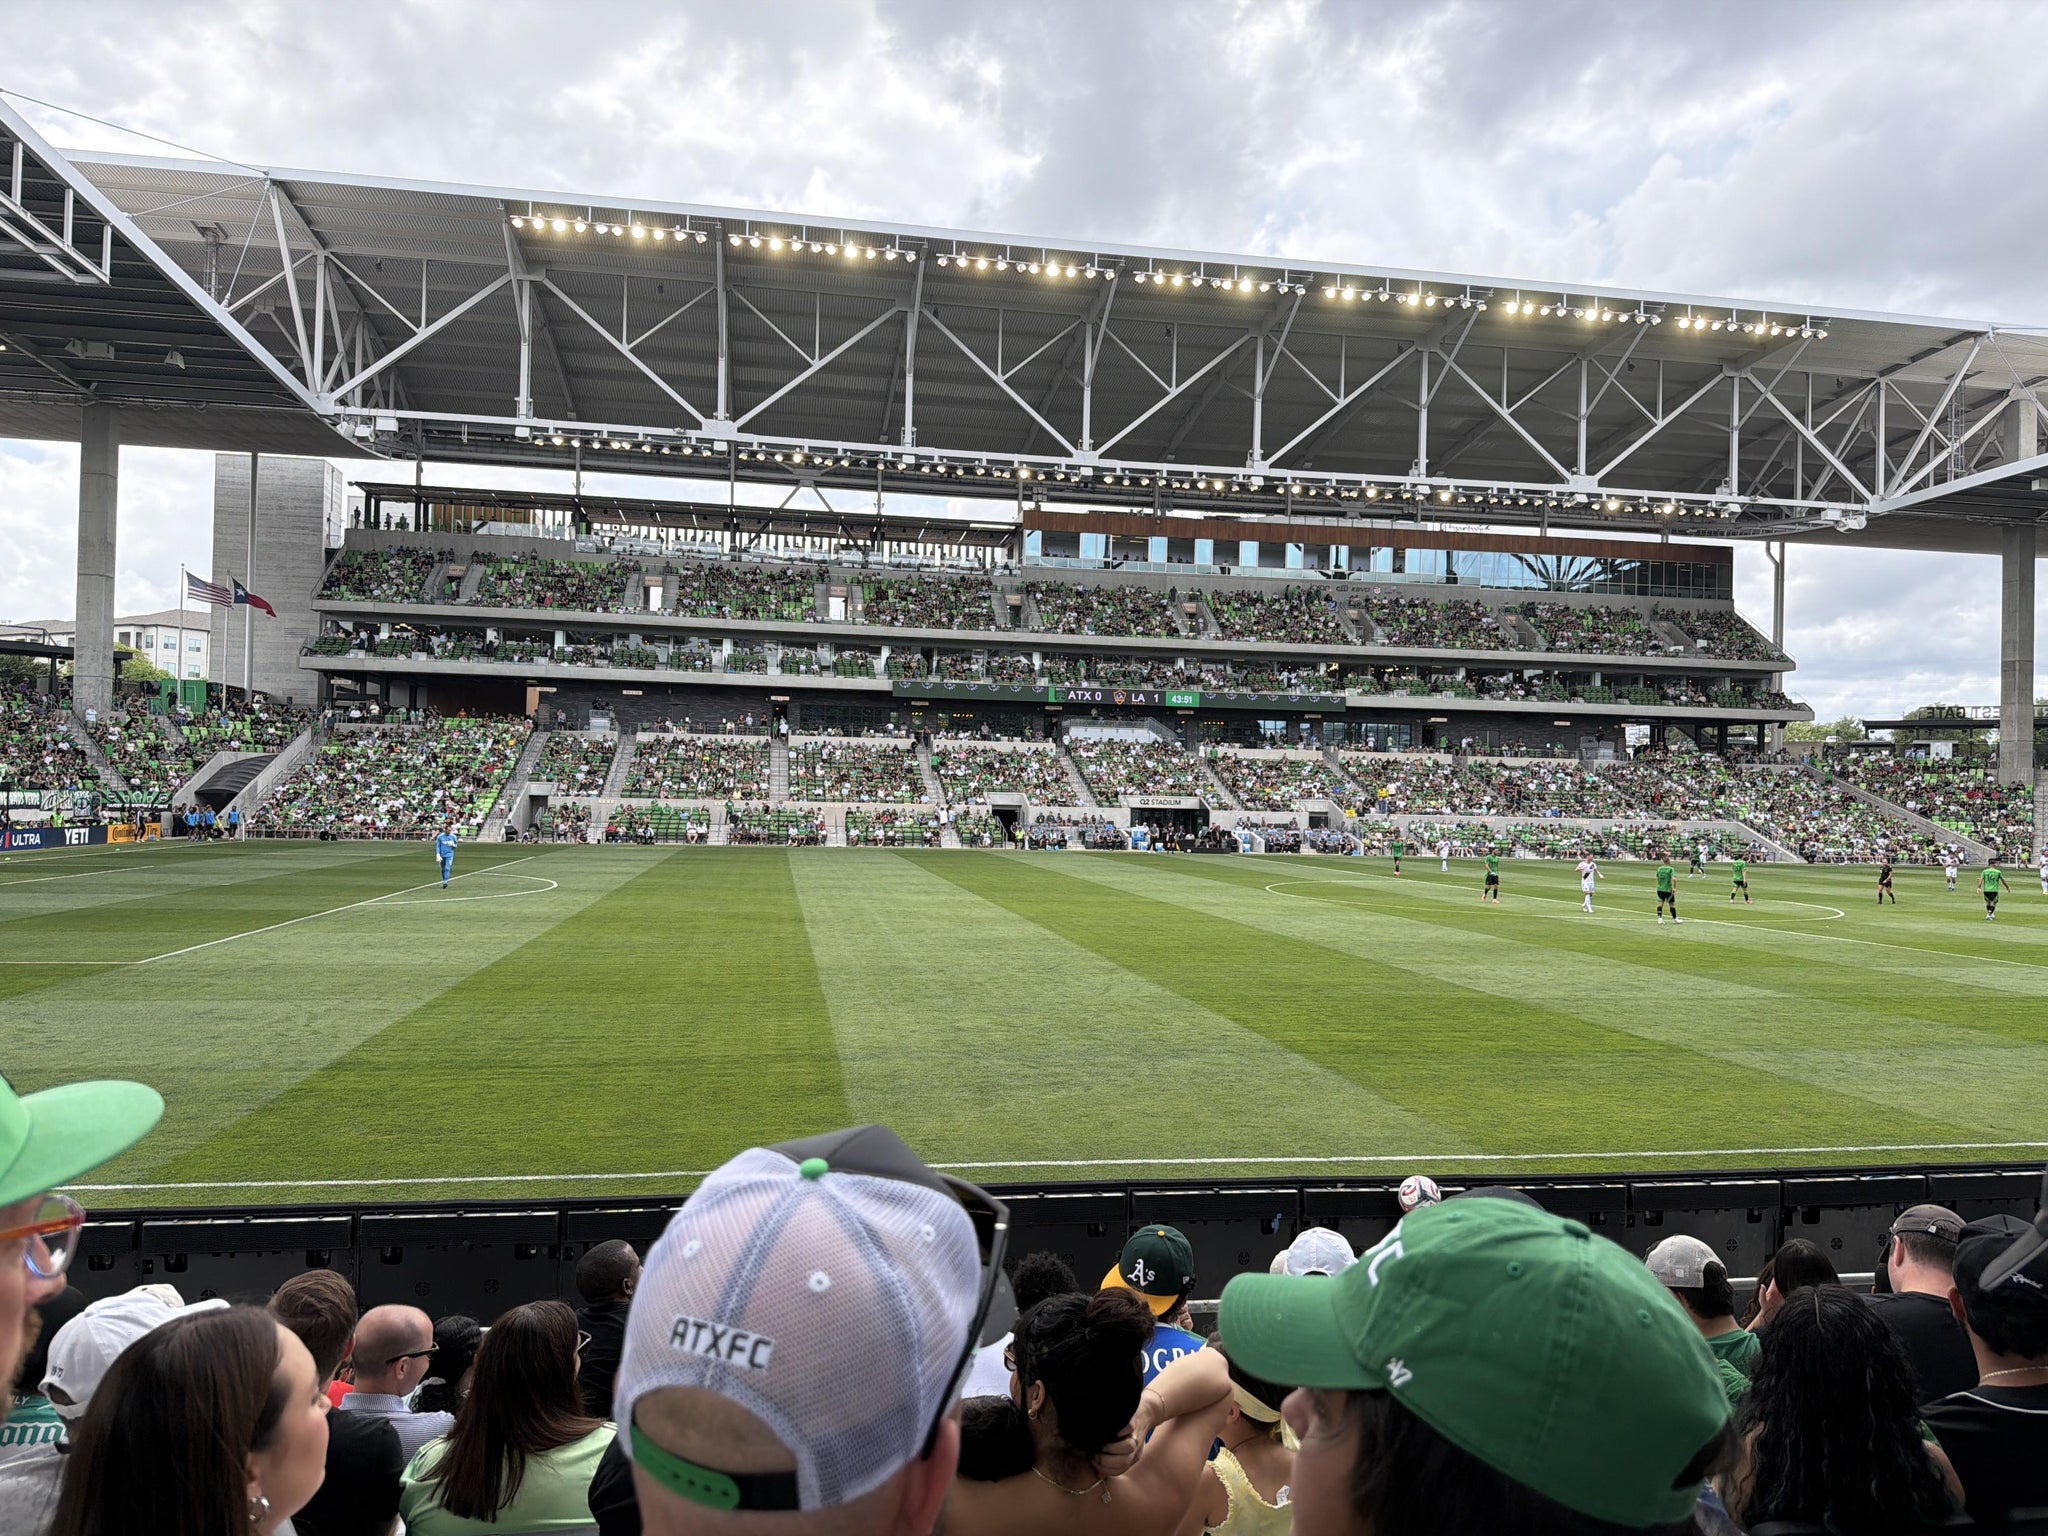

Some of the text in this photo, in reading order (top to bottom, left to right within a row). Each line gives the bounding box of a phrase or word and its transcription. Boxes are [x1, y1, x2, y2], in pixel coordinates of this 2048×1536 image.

[1068, 690, 1102, 701] ATX 0
[1131, 693, 1159, 703] LA 1
[1171, 695, 1193, 704] 43:51
[1140, 798, 1181, 806] Q2 STADIUM
[12, 833, 41, 847] ULTRA
[64, 828, 90, 845] YETI
[1127, 1258, 1156, 1287] A's
[671, 1316, 772, 1369] ATXFC
